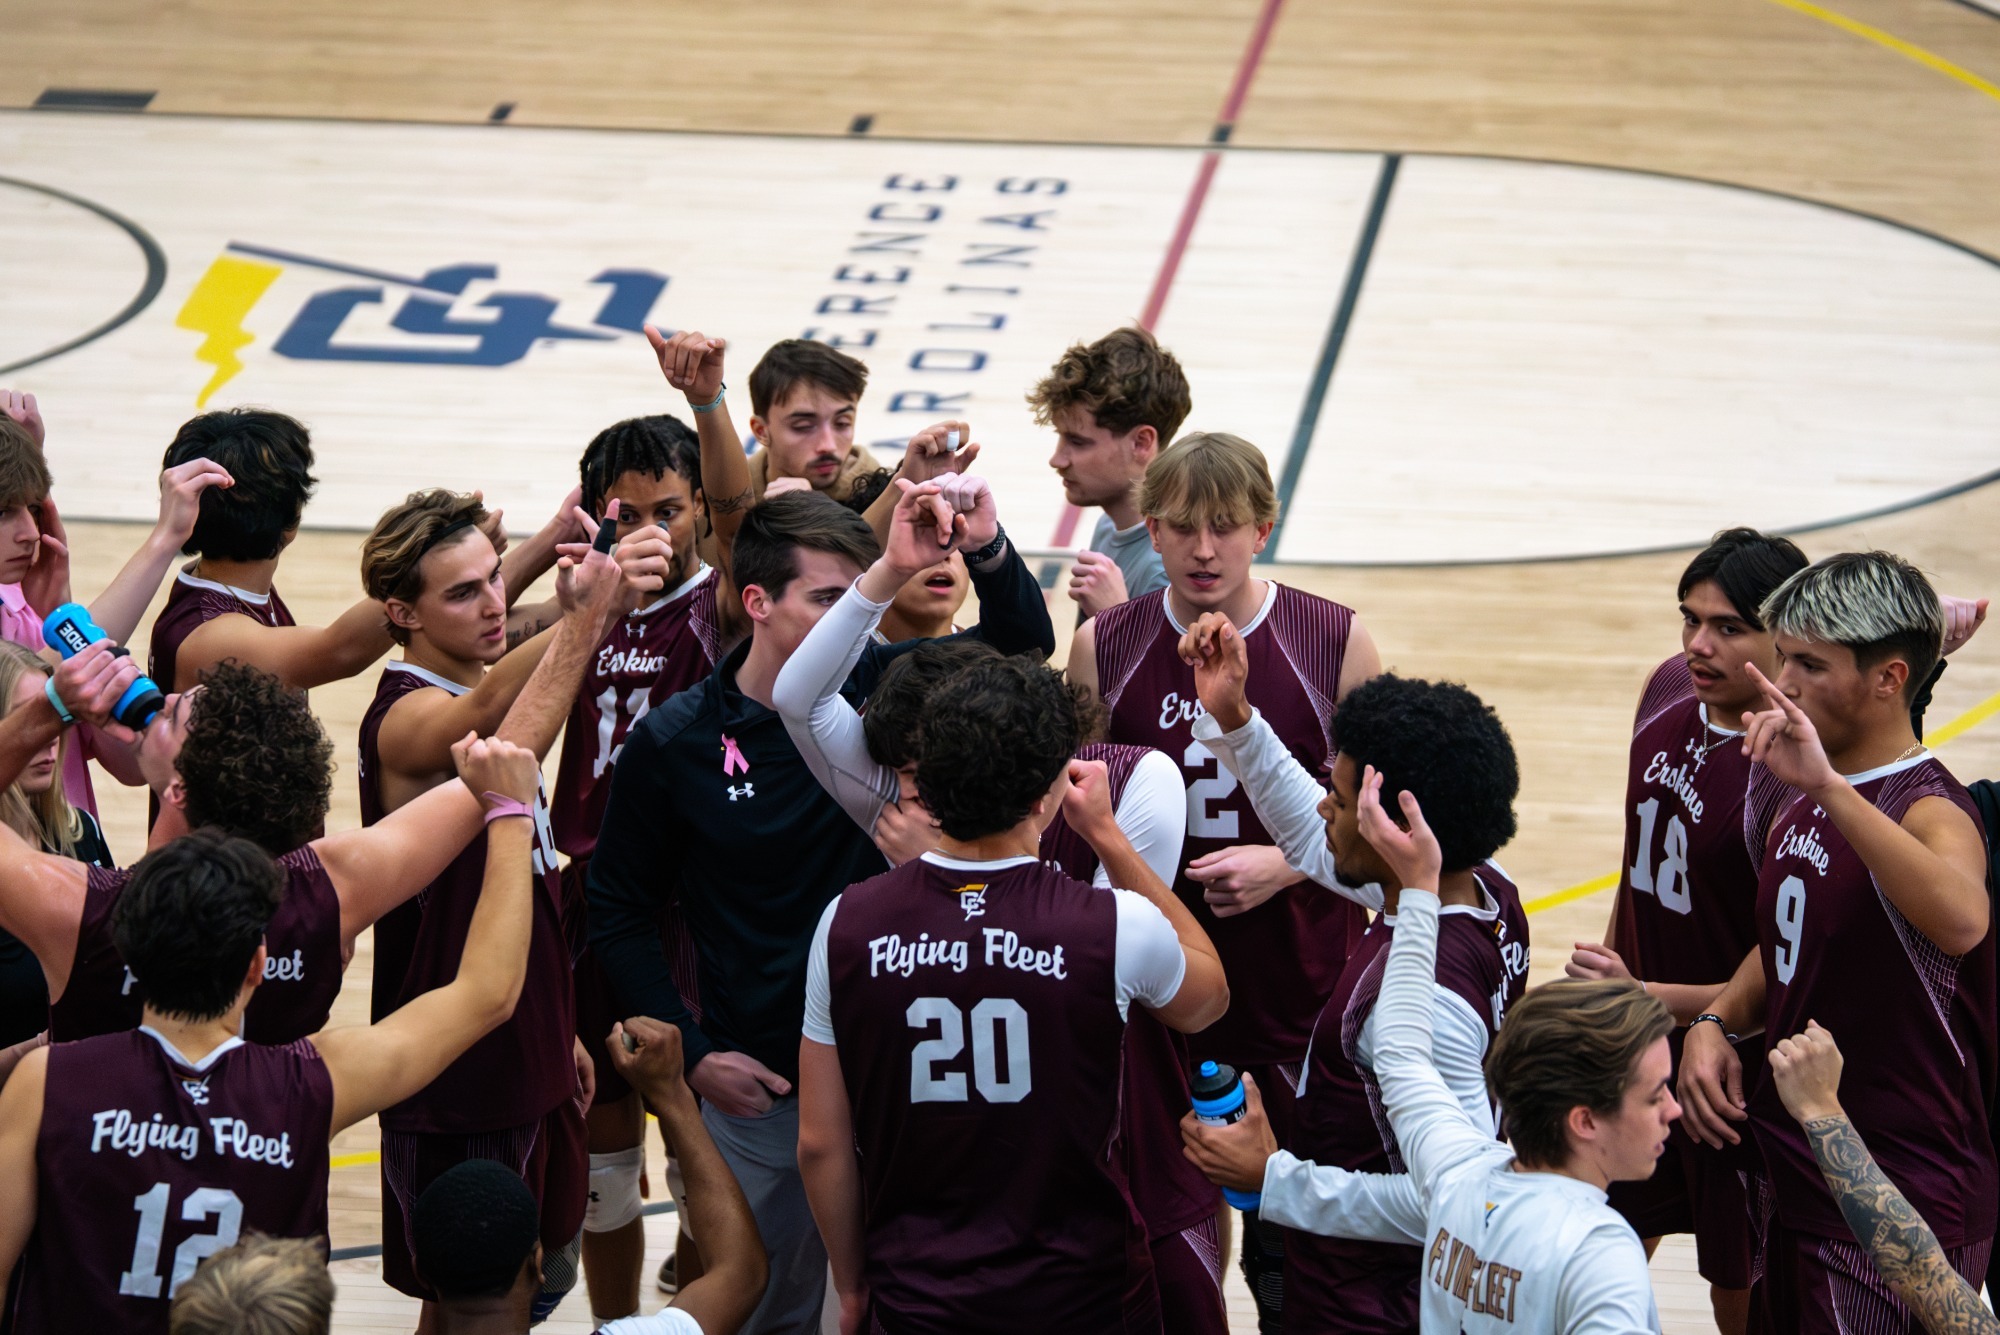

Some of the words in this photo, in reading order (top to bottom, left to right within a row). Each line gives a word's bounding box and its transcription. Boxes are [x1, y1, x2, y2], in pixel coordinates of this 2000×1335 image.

[1643, 750, 1704, 824] Erskine
[1629, 796, 1693, 916] 18
[1775, 824, 1830, 877] Erskine
[262, 948, 305, 982] eet
[868, 933, 968, 979] Flying
[982, 927, 1068, 981] Fleet
[1774, 874, 1807, 987] 9
[905, 997, 1033, 1104] 20
[91, 1108, 200, 1161] Flying
[209, 1116, 294, 1169] Fleet
[118, 1181, 244, 1300] 12
